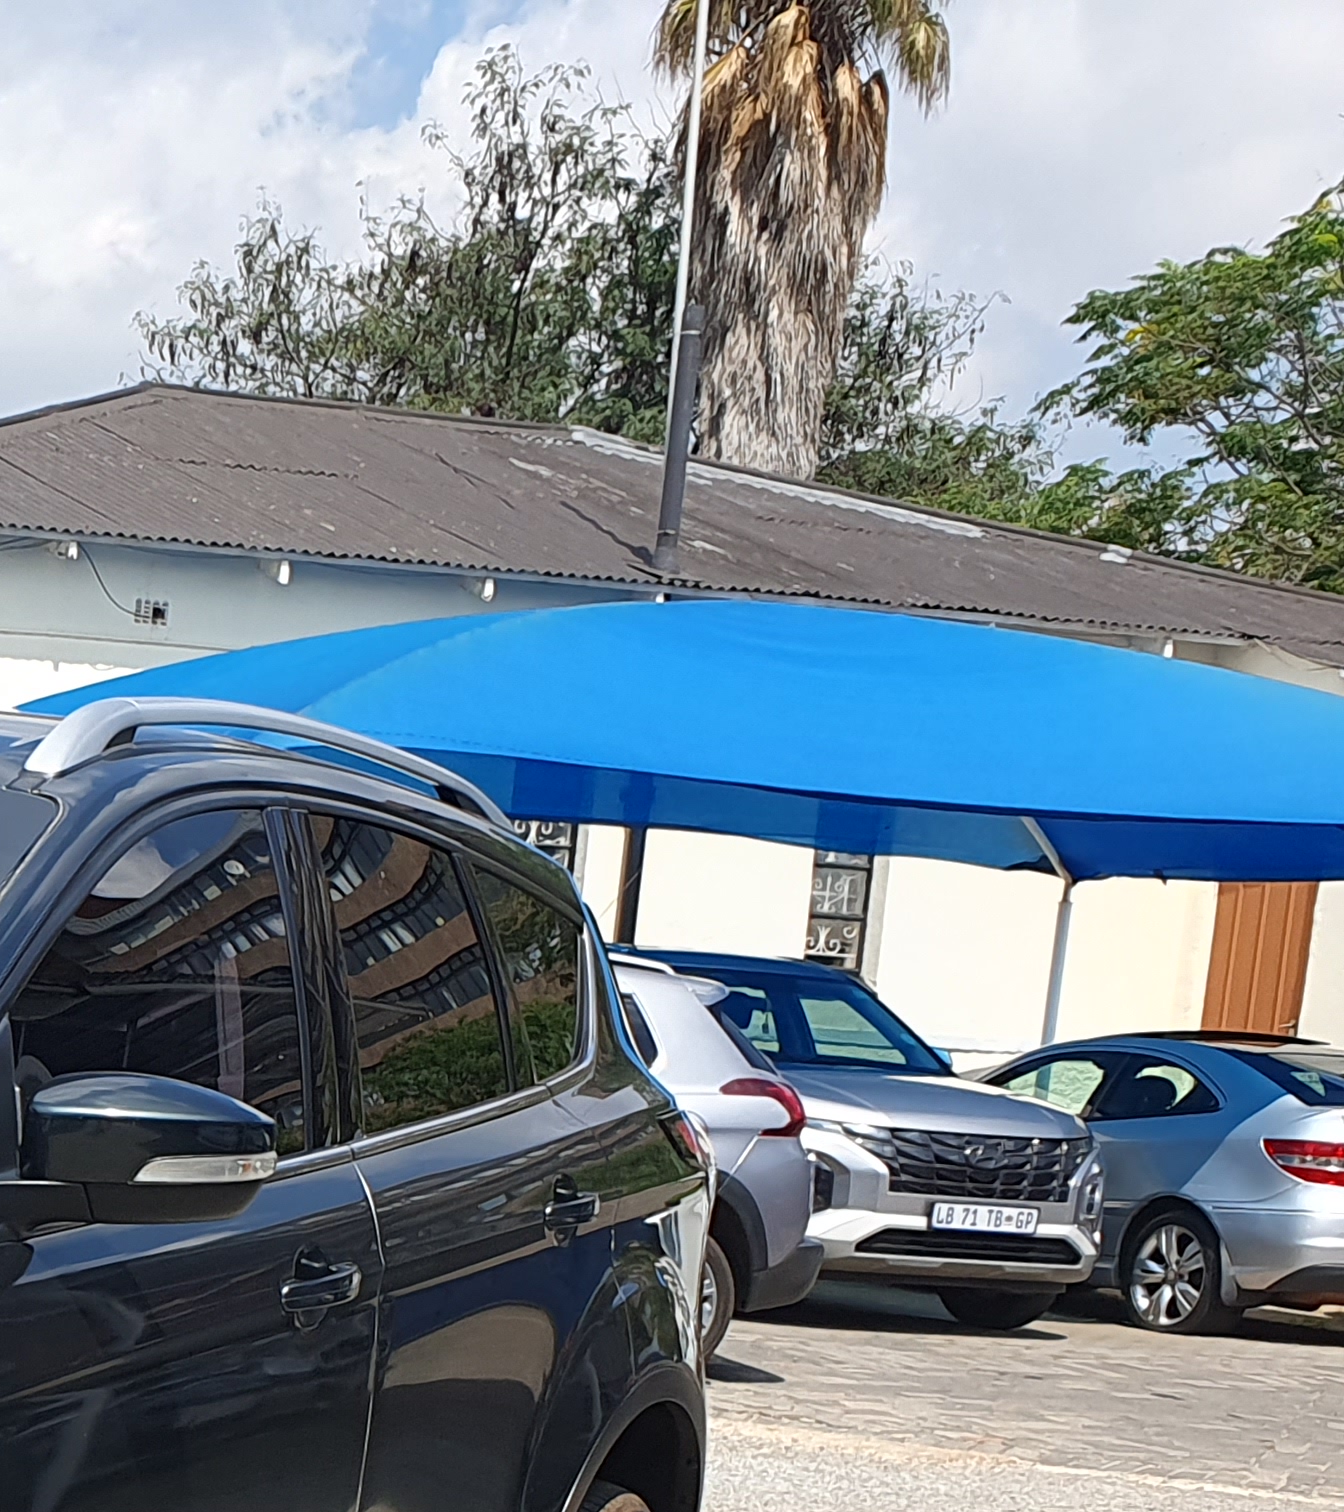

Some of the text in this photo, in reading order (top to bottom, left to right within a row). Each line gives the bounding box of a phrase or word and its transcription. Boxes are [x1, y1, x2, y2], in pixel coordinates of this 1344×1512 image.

[936, 1206, 1034, 1230] LB 71 TB GP
